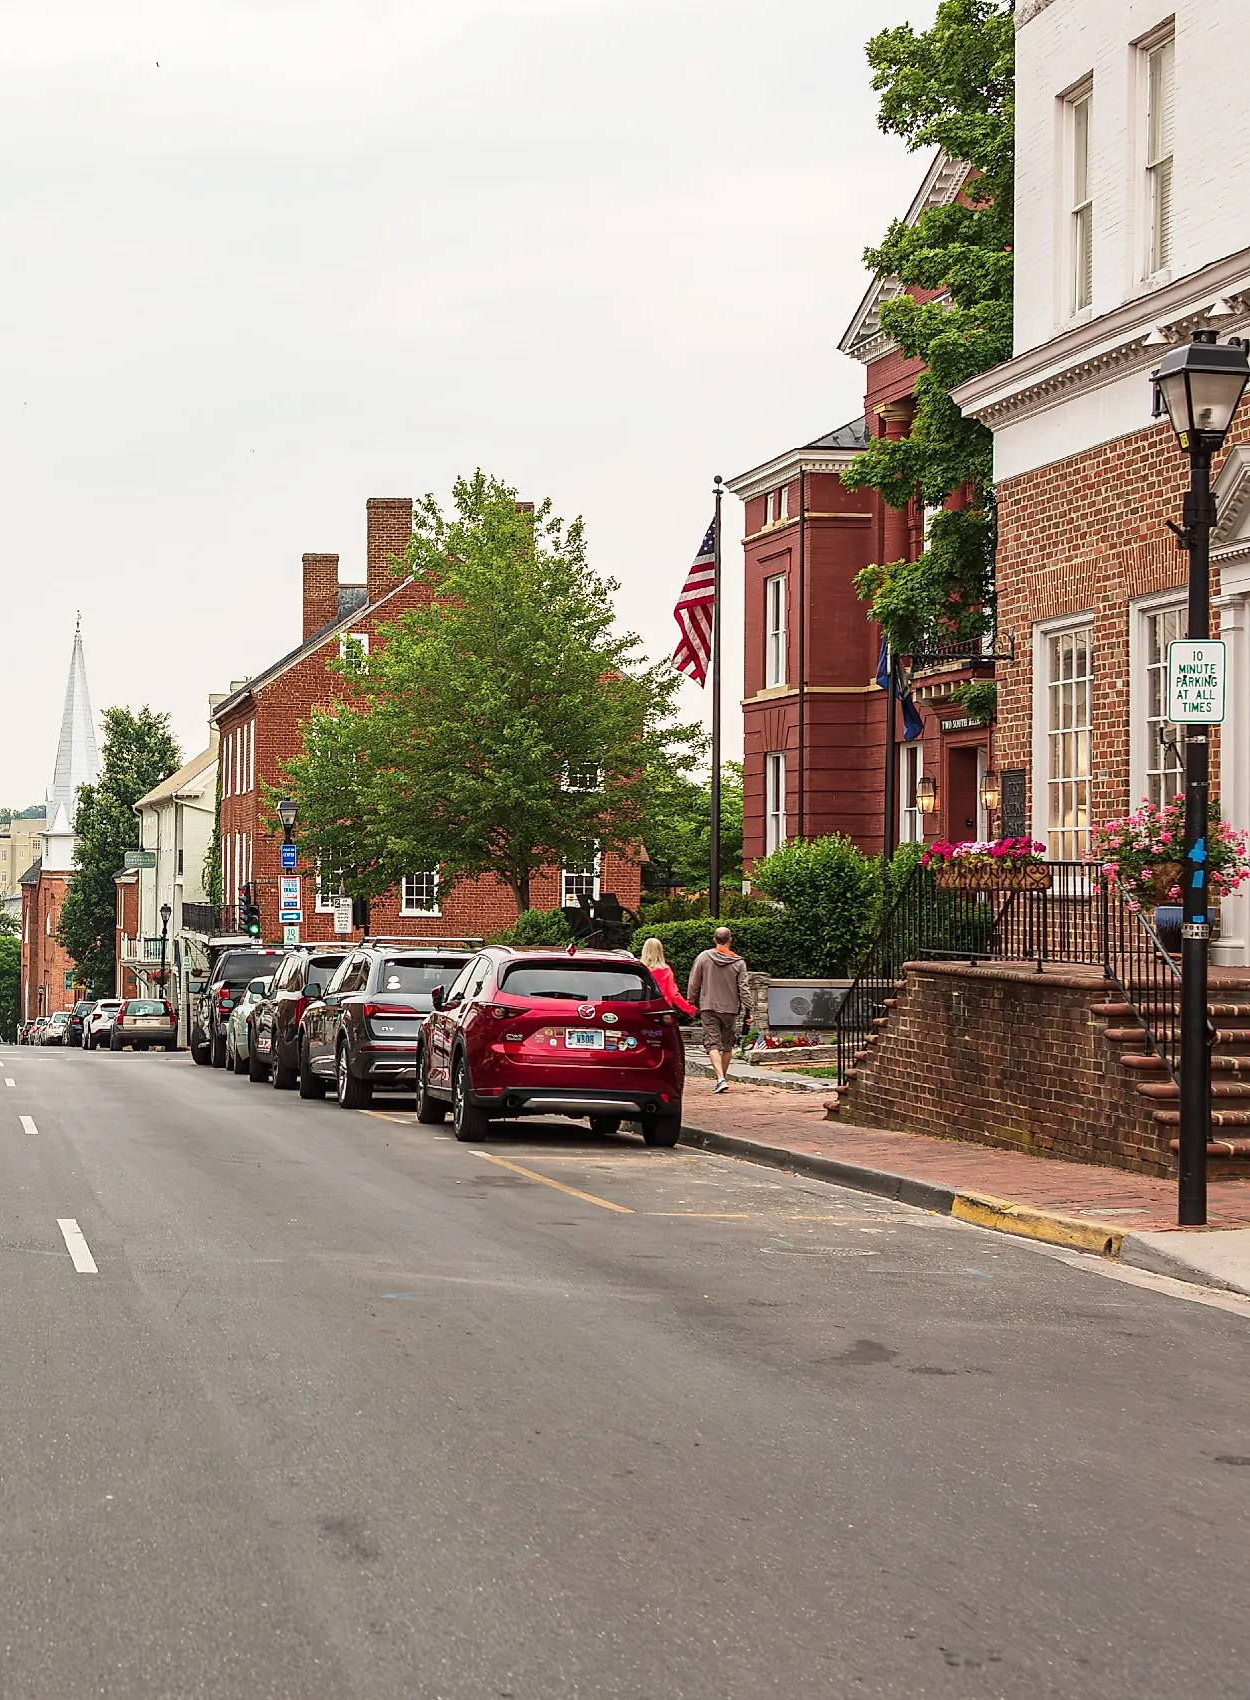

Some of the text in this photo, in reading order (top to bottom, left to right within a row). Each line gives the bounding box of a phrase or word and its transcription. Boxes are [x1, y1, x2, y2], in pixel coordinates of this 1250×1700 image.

[1192, 650, 1203, 661] 10
[1178, 664, 1217, 674] MINUTE
[1176, 676, 1218, 688] PARKING
[1176, 689, 1216, 700] AT ALL
[1182, 702, 1212, 713] TIMES
[952, 718, 968, 728] SOUTH
[287, 928, 295, 936] 10
